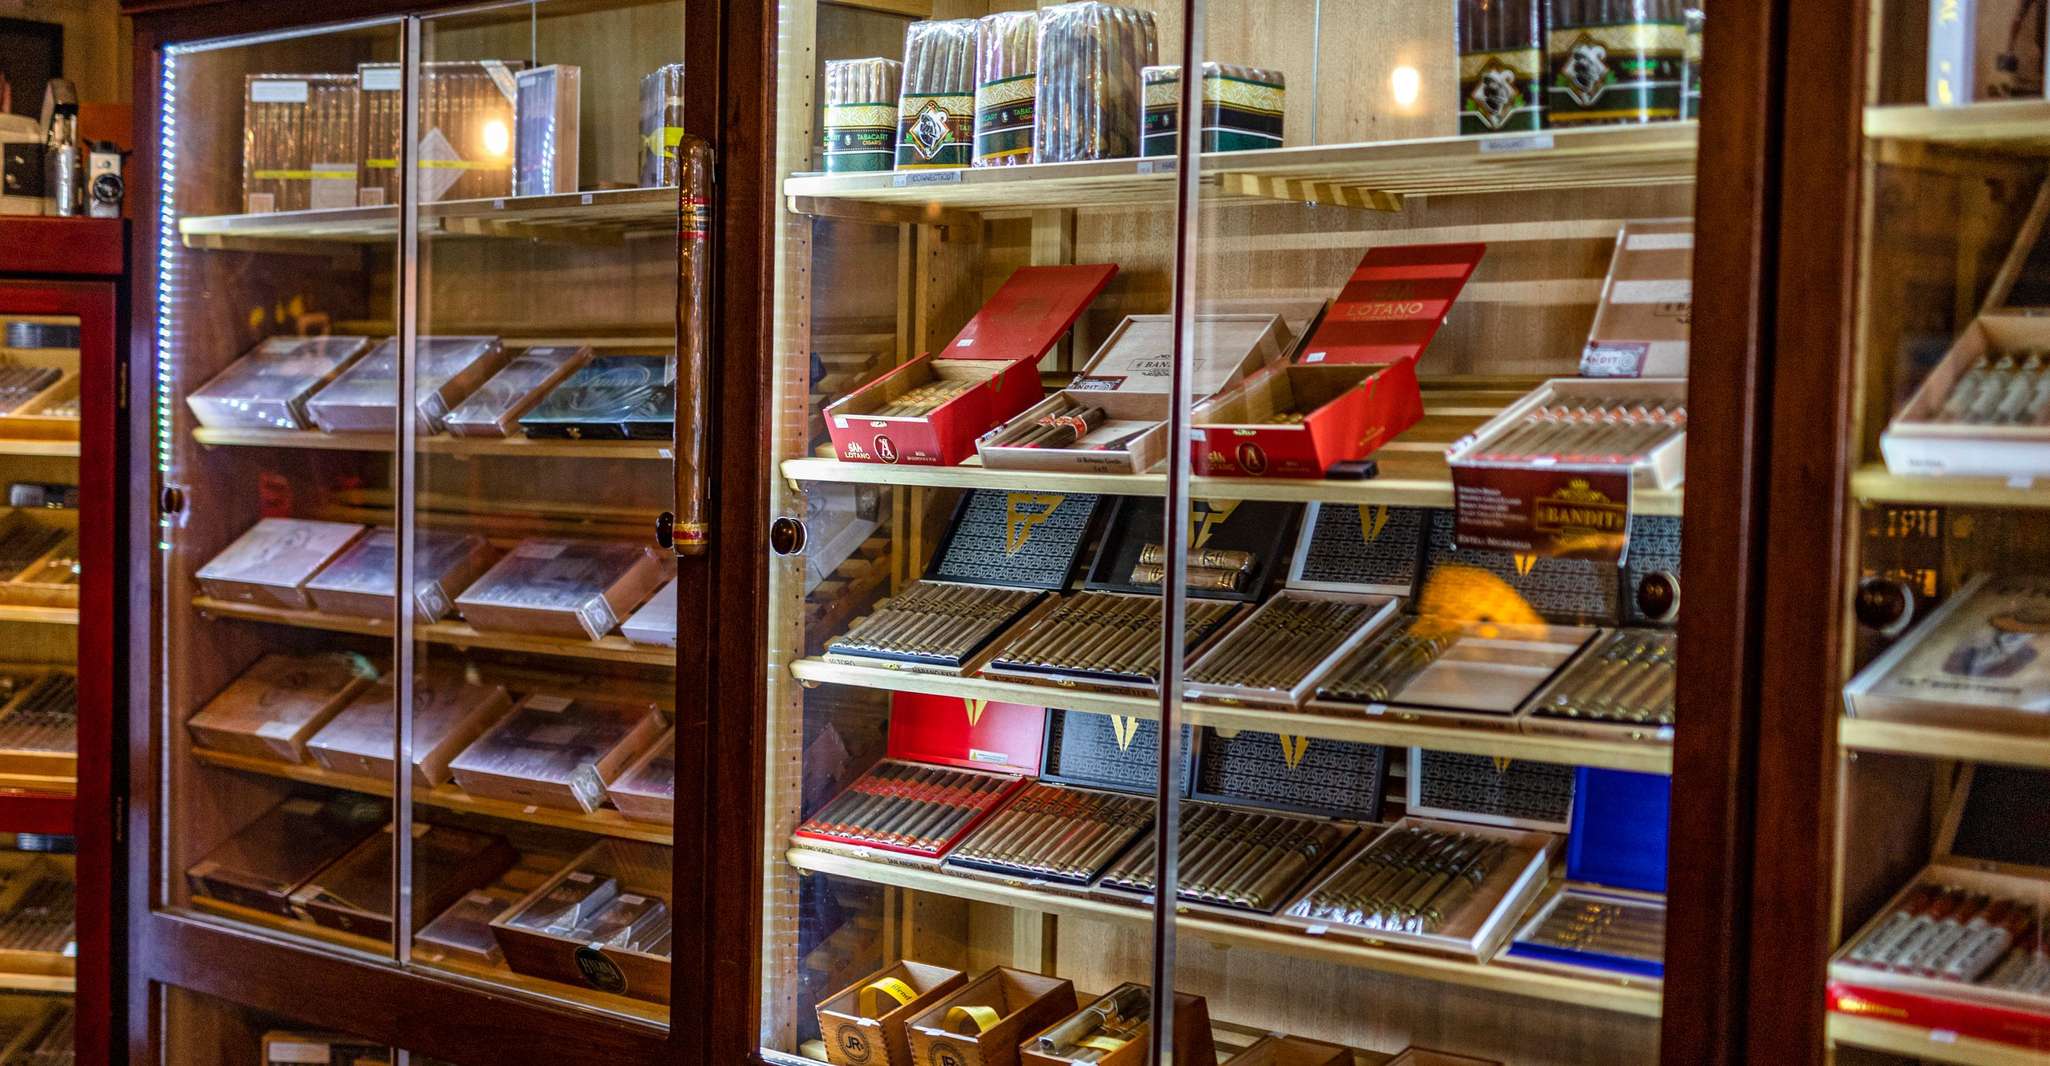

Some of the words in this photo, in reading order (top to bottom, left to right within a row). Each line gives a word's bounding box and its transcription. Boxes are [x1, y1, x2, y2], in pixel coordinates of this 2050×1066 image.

[857, 133, 889, 142] TABACART
[1346, 301, 1424, 317] LOTANO
[844, 450, 871, 460] LOTANO
[1547, 507, 1617, 528] BANDIT
